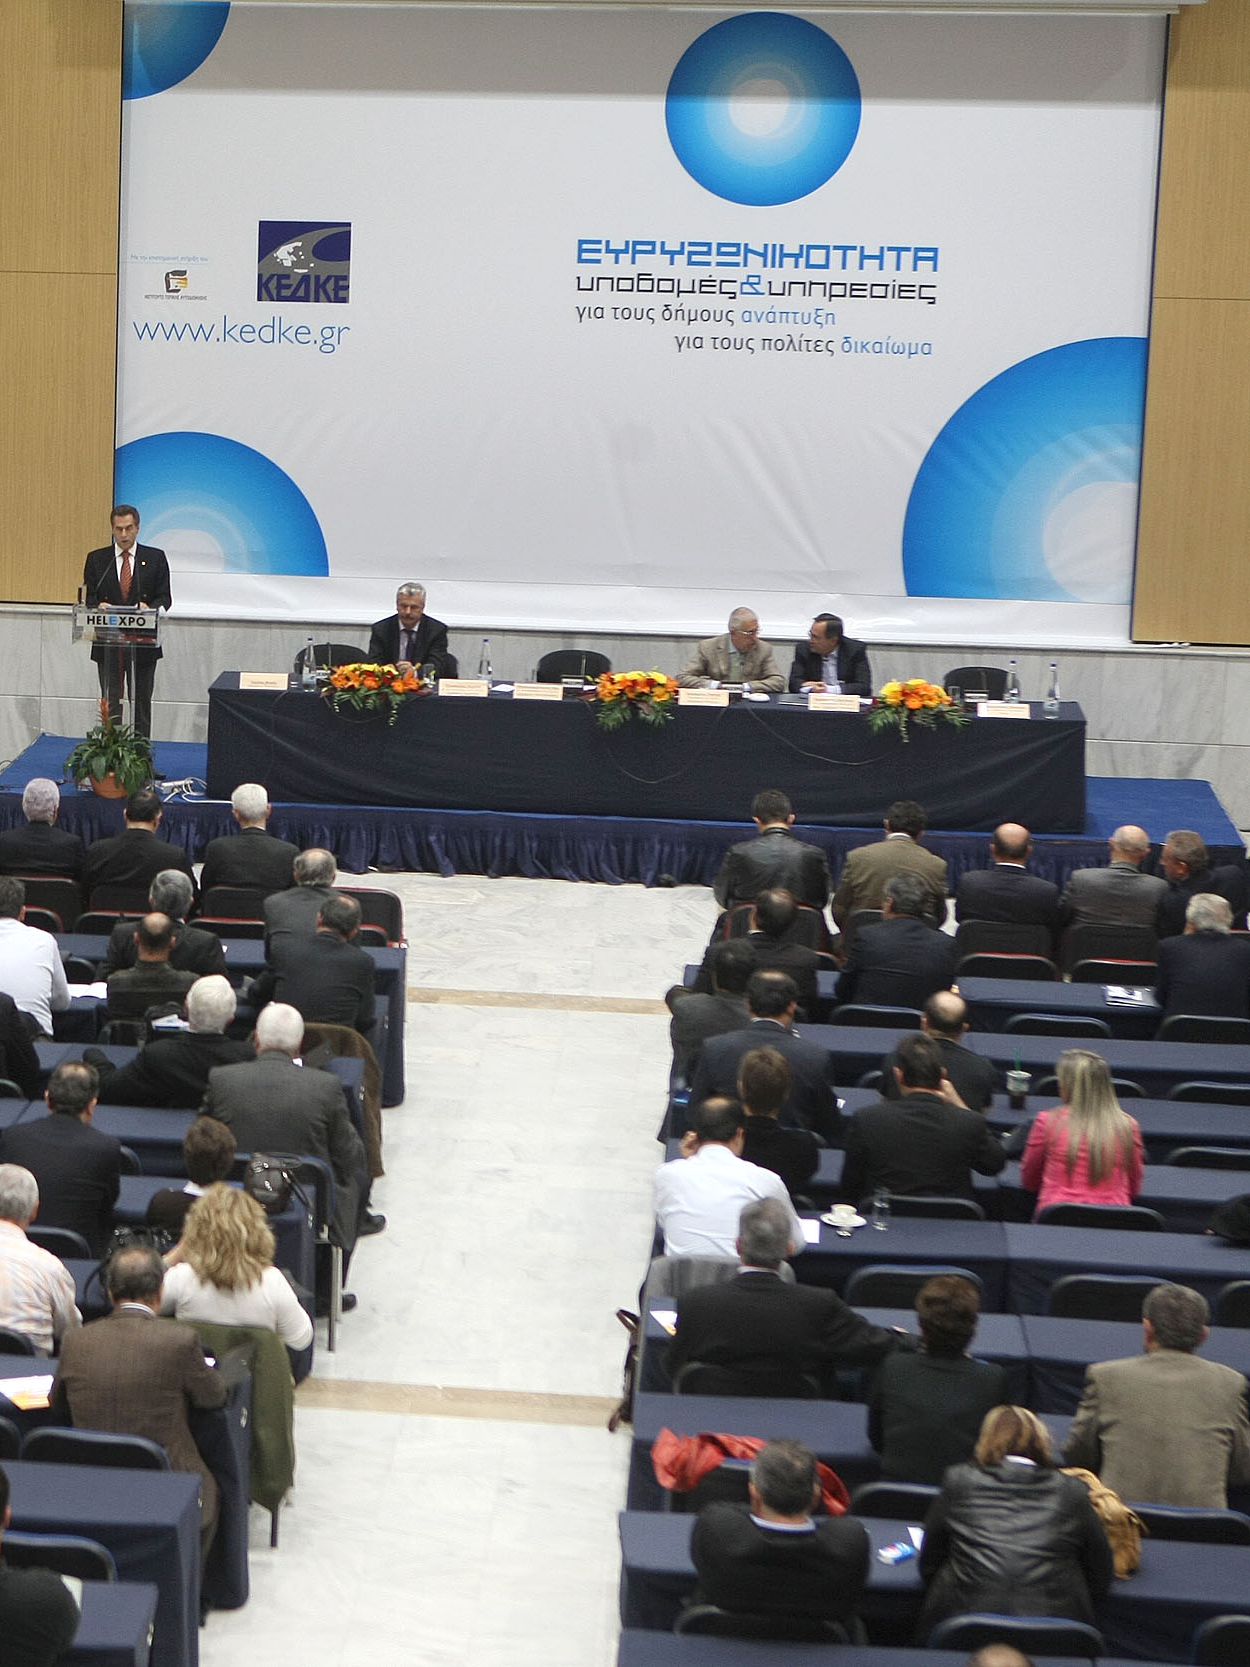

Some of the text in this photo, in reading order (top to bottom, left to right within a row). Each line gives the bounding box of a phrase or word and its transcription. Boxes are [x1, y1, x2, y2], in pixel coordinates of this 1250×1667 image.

[575, 302, 836, 329] για τους δήμους ανάπτυξη
[132, 314, 351, 354] www.kedke.gr
[674, 333, 933, 359] για τους πολίτες δικαίωμα
[87, 615, 146, 627] HELEXPO
